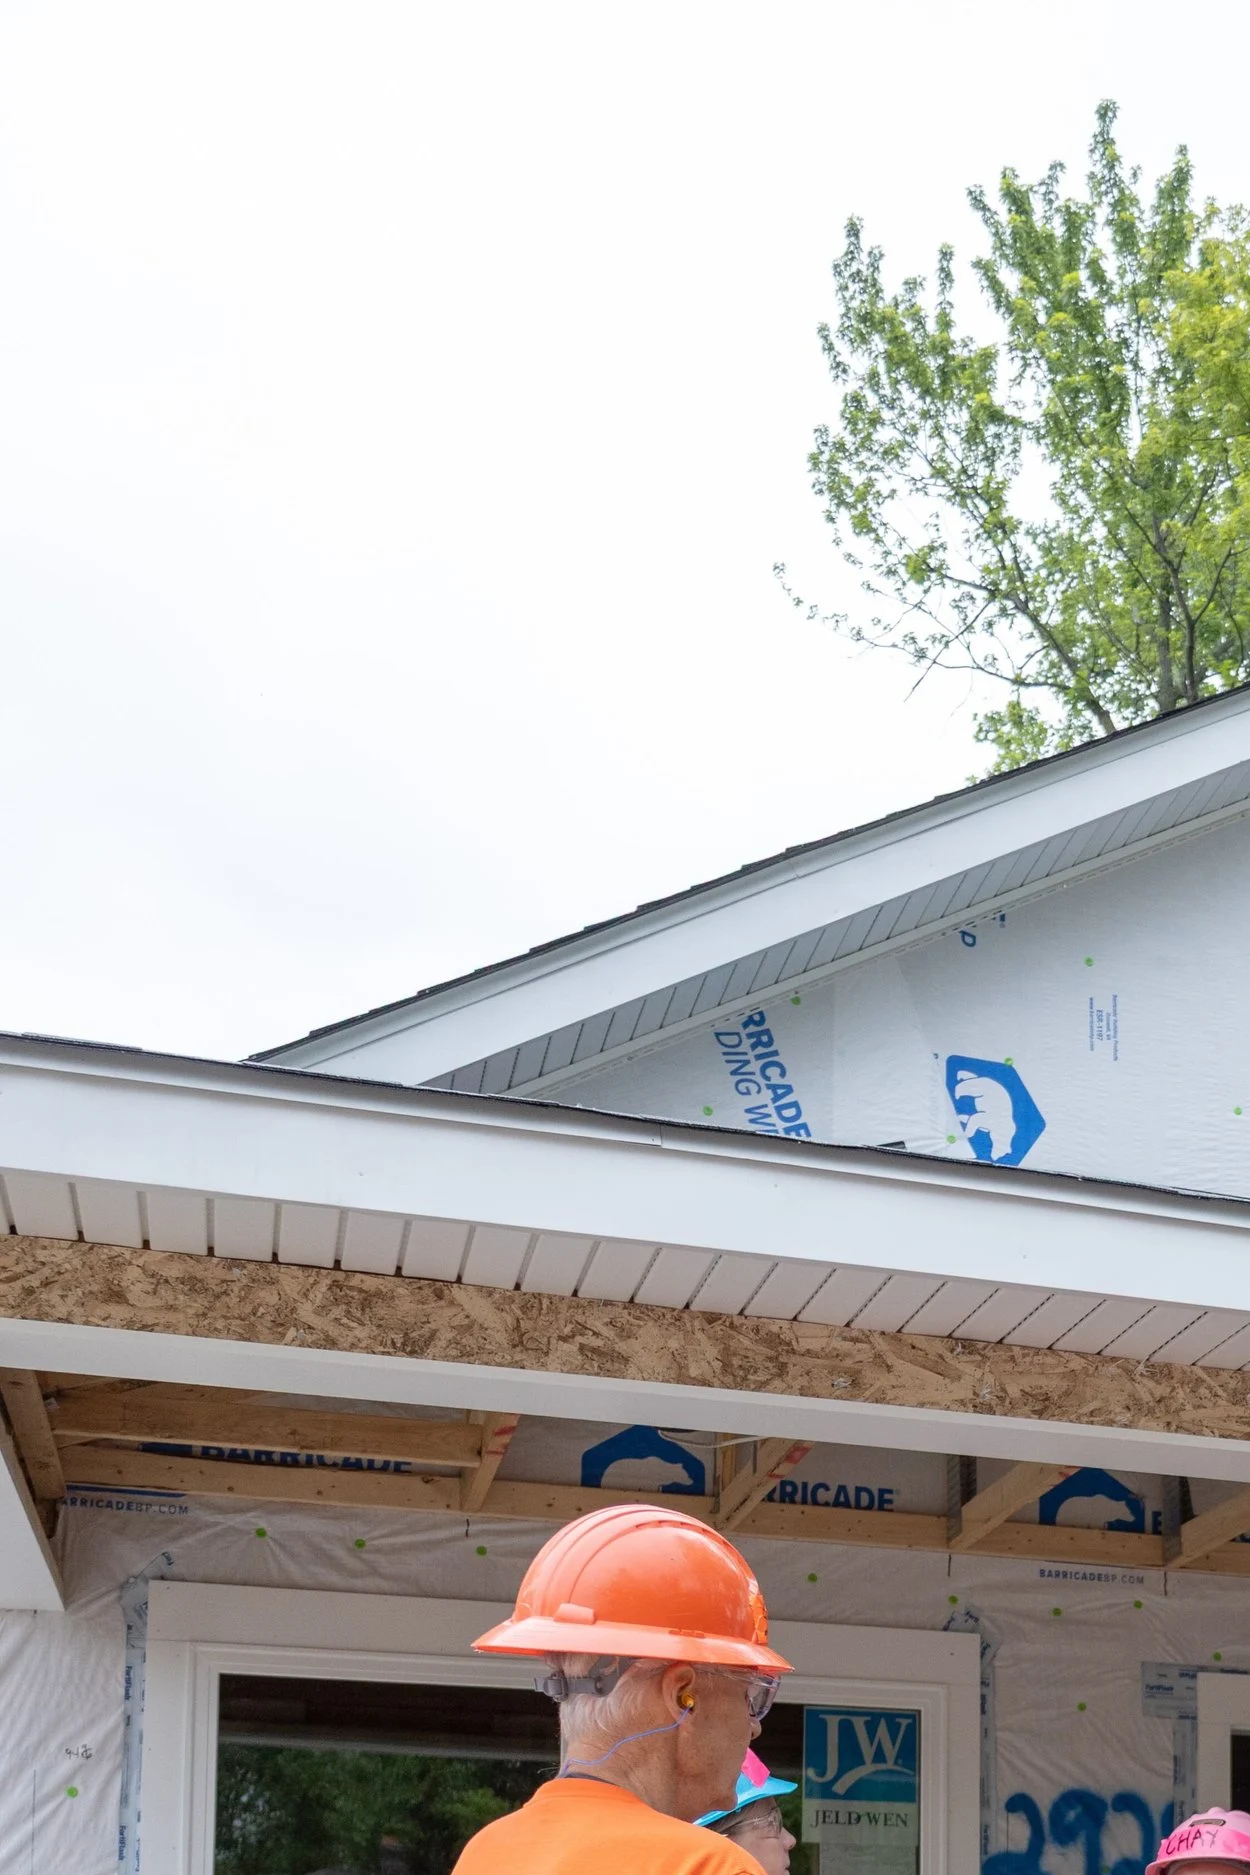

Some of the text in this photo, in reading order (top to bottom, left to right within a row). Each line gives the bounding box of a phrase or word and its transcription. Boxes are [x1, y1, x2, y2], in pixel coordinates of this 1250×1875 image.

[714, 1031, 779, 1135] DING W
[1039, 1569, 1145, 1585] BARRICADEBP.COM
[806, 1714, 913, 1784] JW
[1166, 1829, 1219, 1855] CHAY
